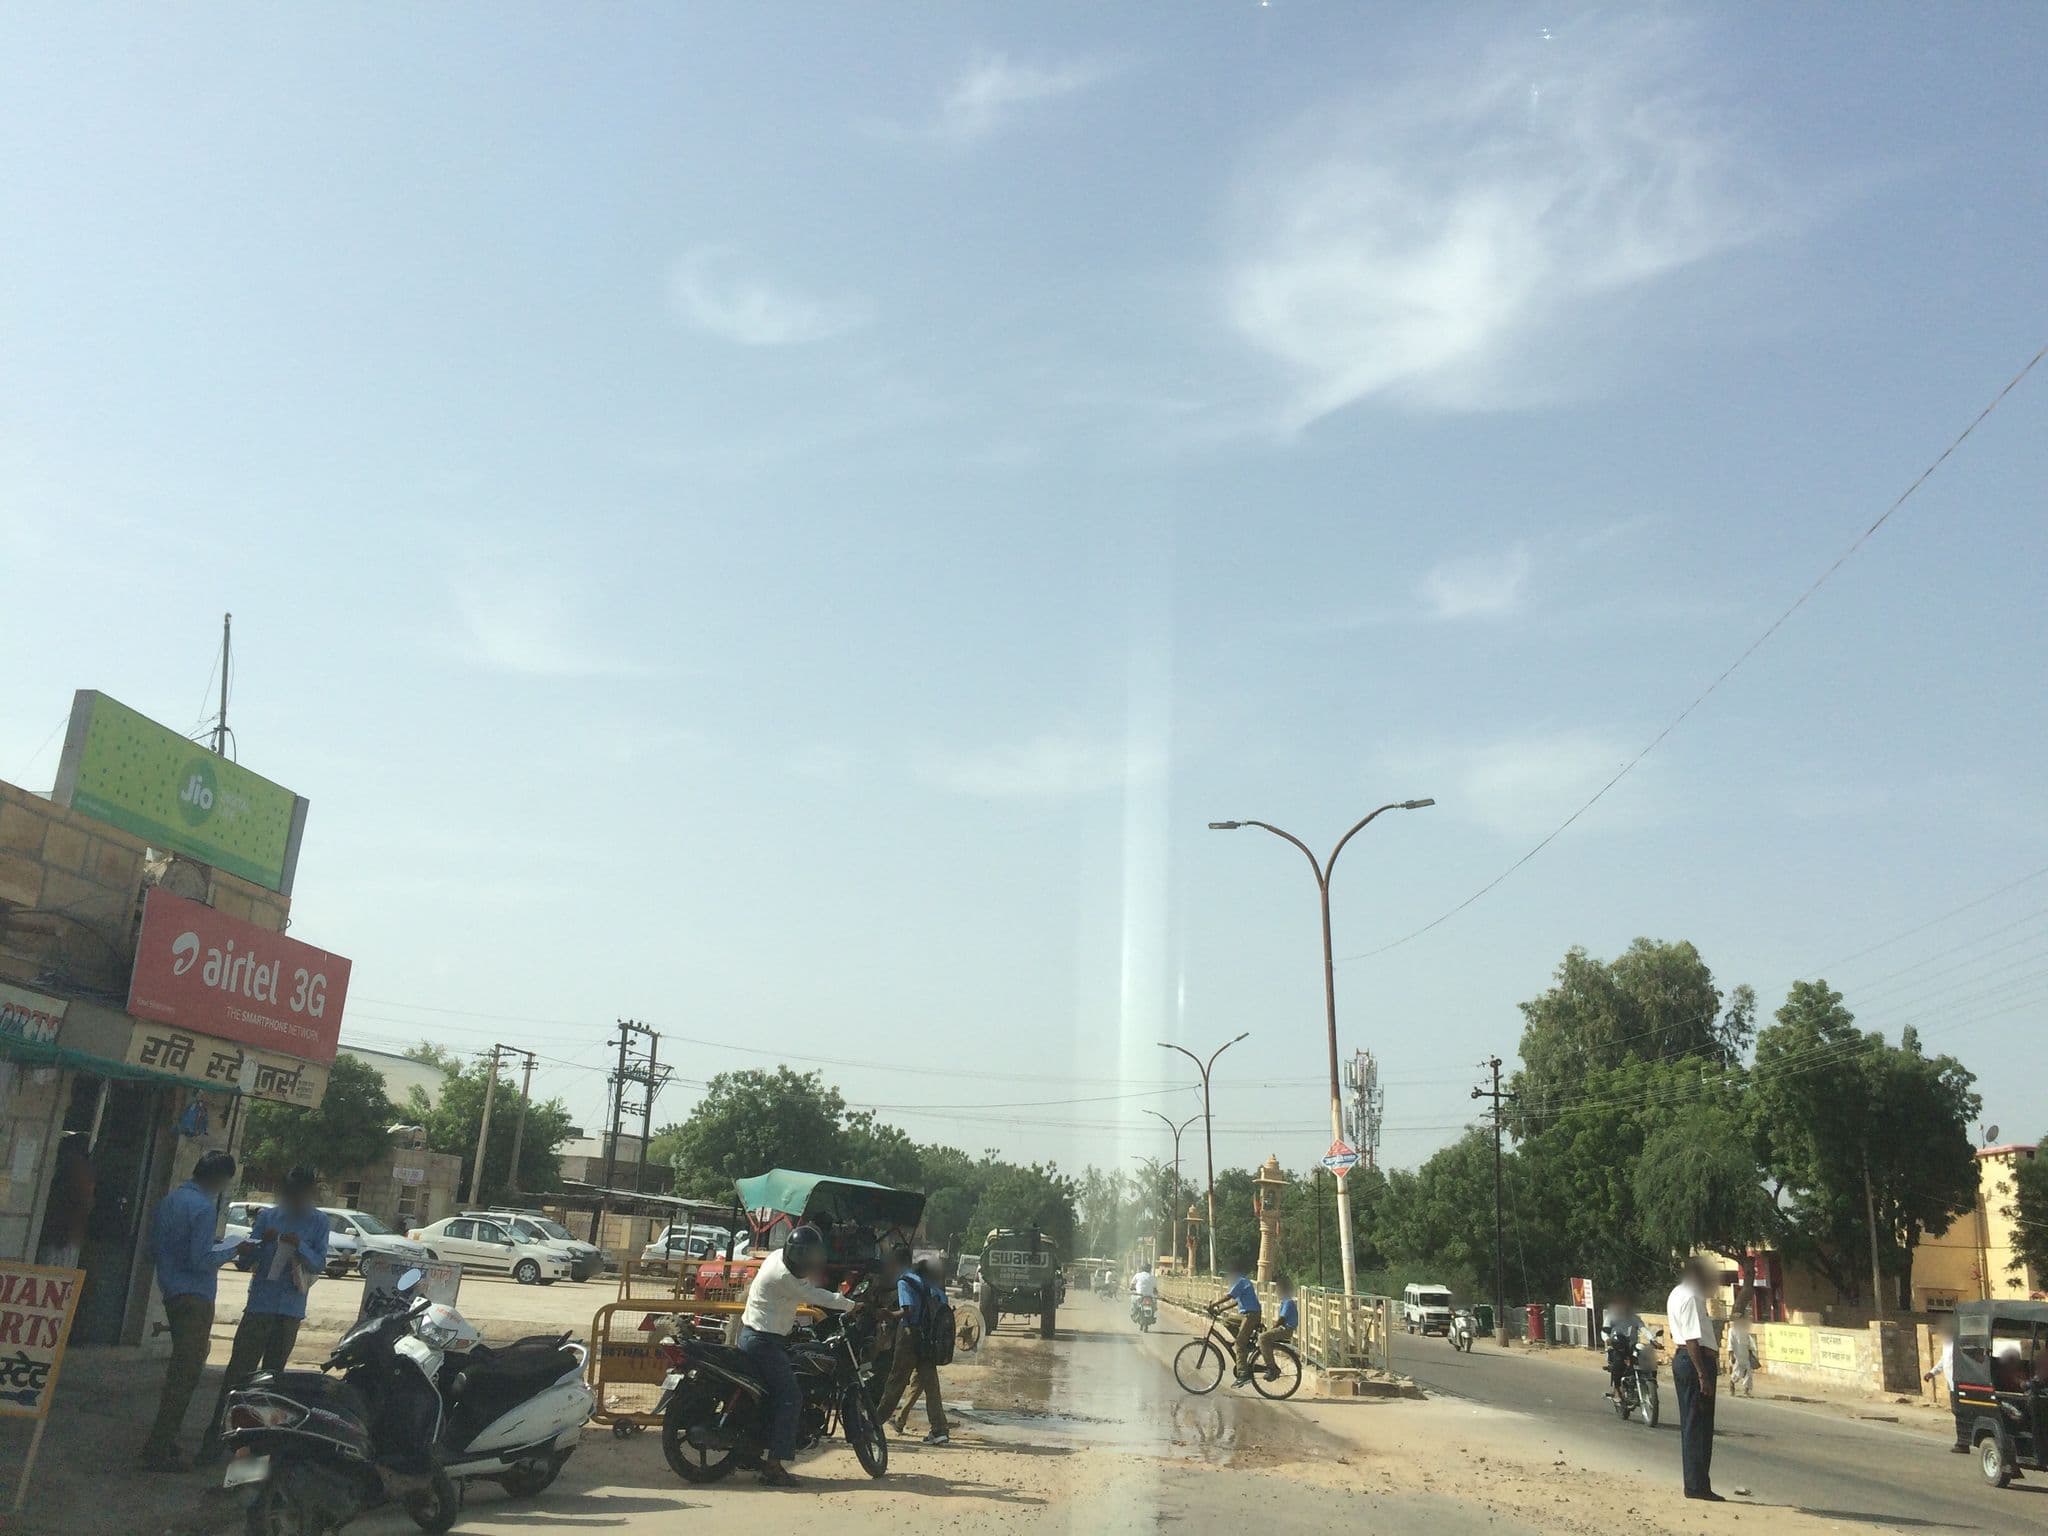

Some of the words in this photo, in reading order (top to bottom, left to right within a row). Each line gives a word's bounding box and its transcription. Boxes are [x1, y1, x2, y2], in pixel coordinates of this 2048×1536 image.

[181, 775, 213, 810] Jio
[202, 939, 281, 1005] airtel
[289, 968, 327, 1019] 3G
[226, 1006, 242, 1022] THE
[240, 1010, 289, 1033] SMARTPHONE
[139, 1033, 195, 1072] रवि
